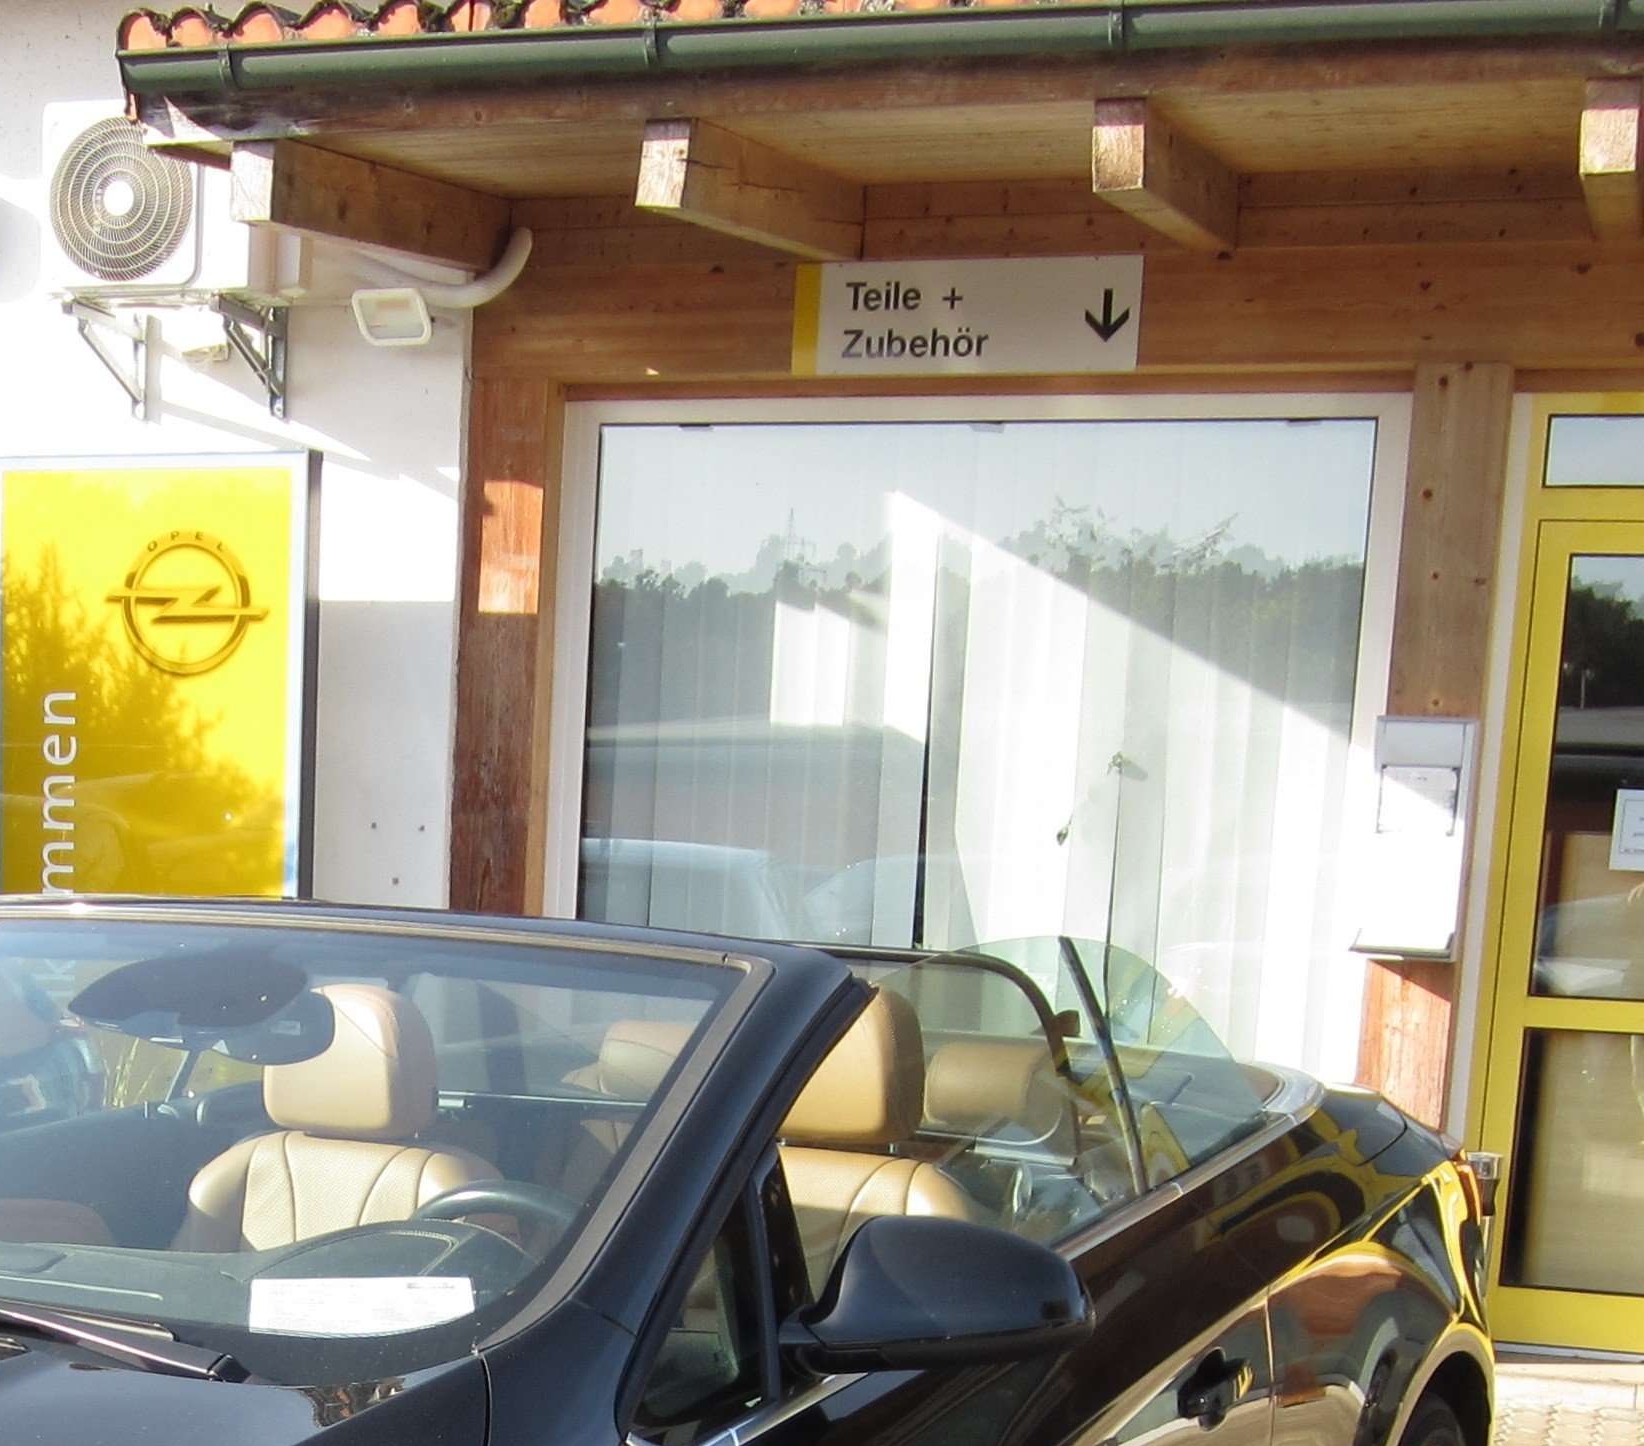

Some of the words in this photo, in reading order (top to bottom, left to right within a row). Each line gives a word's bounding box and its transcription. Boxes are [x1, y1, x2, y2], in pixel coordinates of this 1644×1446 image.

[846, 281, 922, 312] Teile
[841, 326, 990, 359] Zubehör
[146, 530, 228, 553] OPEL
